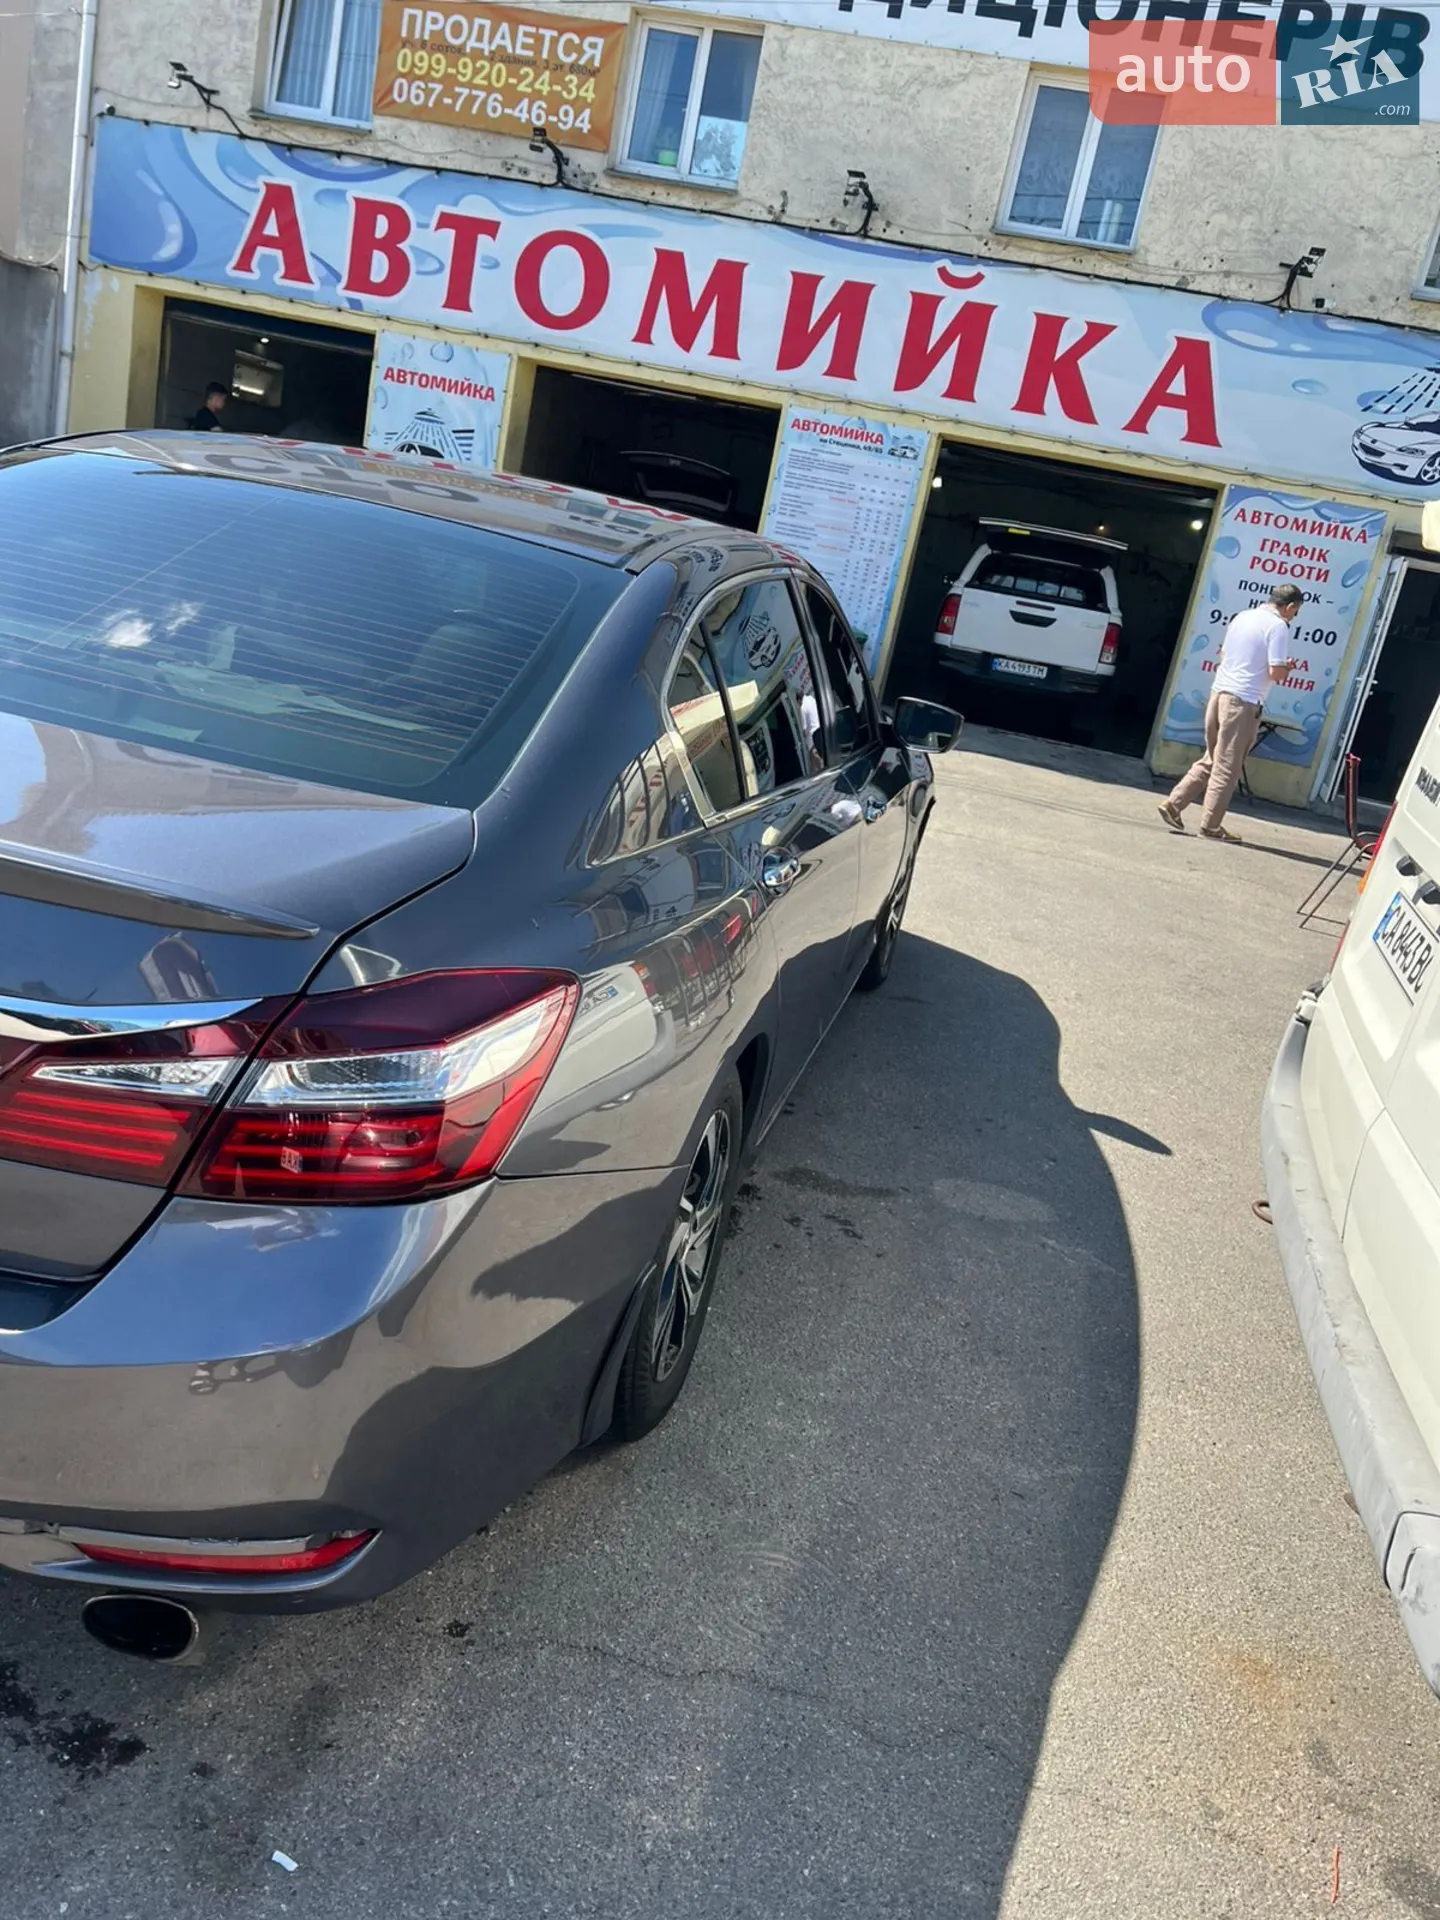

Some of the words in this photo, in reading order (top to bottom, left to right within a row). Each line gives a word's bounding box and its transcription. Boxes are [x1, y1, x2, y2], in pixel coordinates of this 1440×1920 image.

[401, 8, 605, 68] ПРОДАЕТСЯ
[397, 48, 596, 103] 099-920-24-34
[393, 78, 592, 134] 067-776-46-94
[232, 181, 1222, 448] АВТОМИЙКА
[383, 366, 496, 402] АВТОМИЙКА
[1233, 507, 1369, 544] АВТОМИЙКА
[1249, 555, 1331, 583] РОБОТИ
[1259, 537, 1331, 564] ГРАФІК
